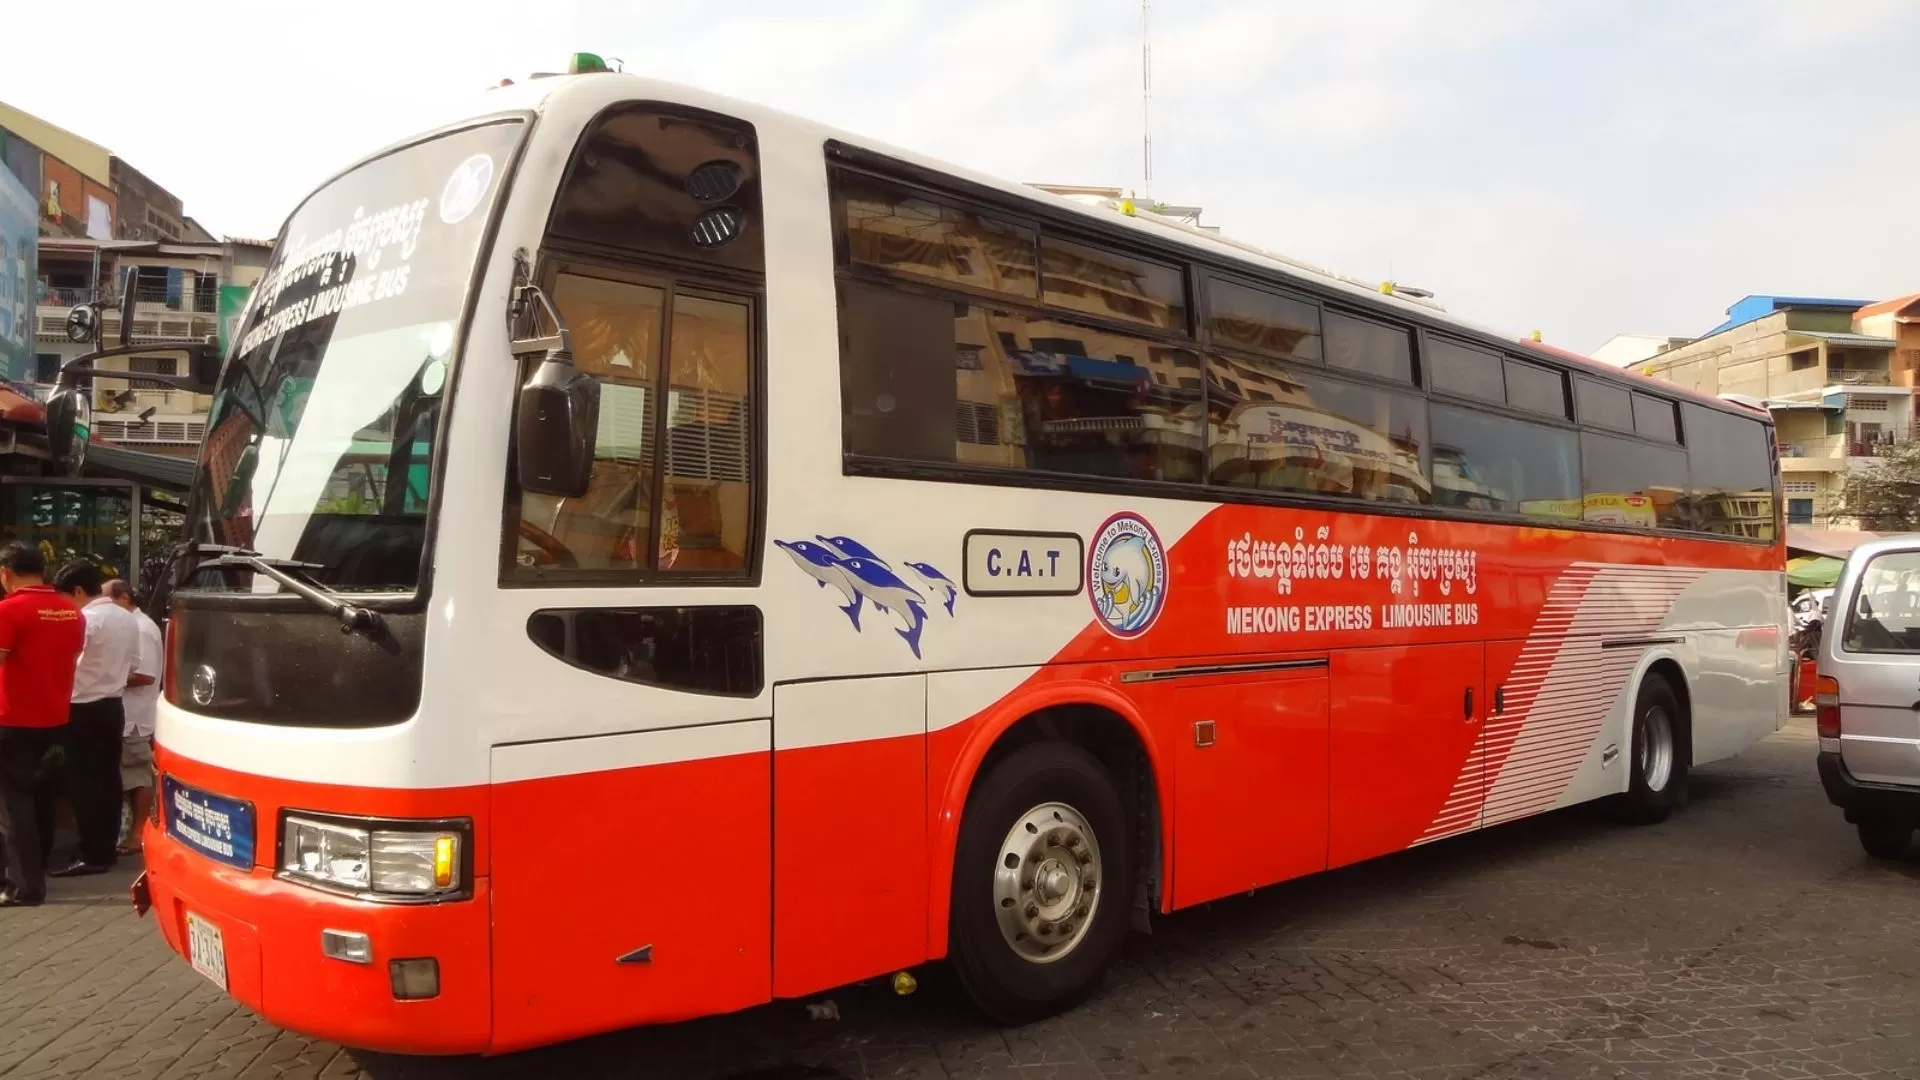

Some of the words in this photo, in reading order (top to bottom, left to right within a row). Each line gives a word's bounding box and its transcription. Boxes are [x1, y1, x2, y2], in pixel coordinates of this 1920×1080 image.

[264, 297, 311, 343] EXPRESS
[306, 275, 377, 323] LIMOUSINE
[374, 264, 411, 301] BUS
[986, 547, 1060, 577] C.A.T
[1092, 537, 1109, 592] Welcome
[1107, 527, 1117, 539] to
[1116, 520, 1148, 539] Mekong
[1147, 536, 1162, 583] Express
[1227, 607, 1299, 634] MEKONG
[1305, 605, 1371, 631] EXPRESS
[1382, 604, 1451, 629] LIMOUSINE
[1454, 603, 1477, 625] BUS
